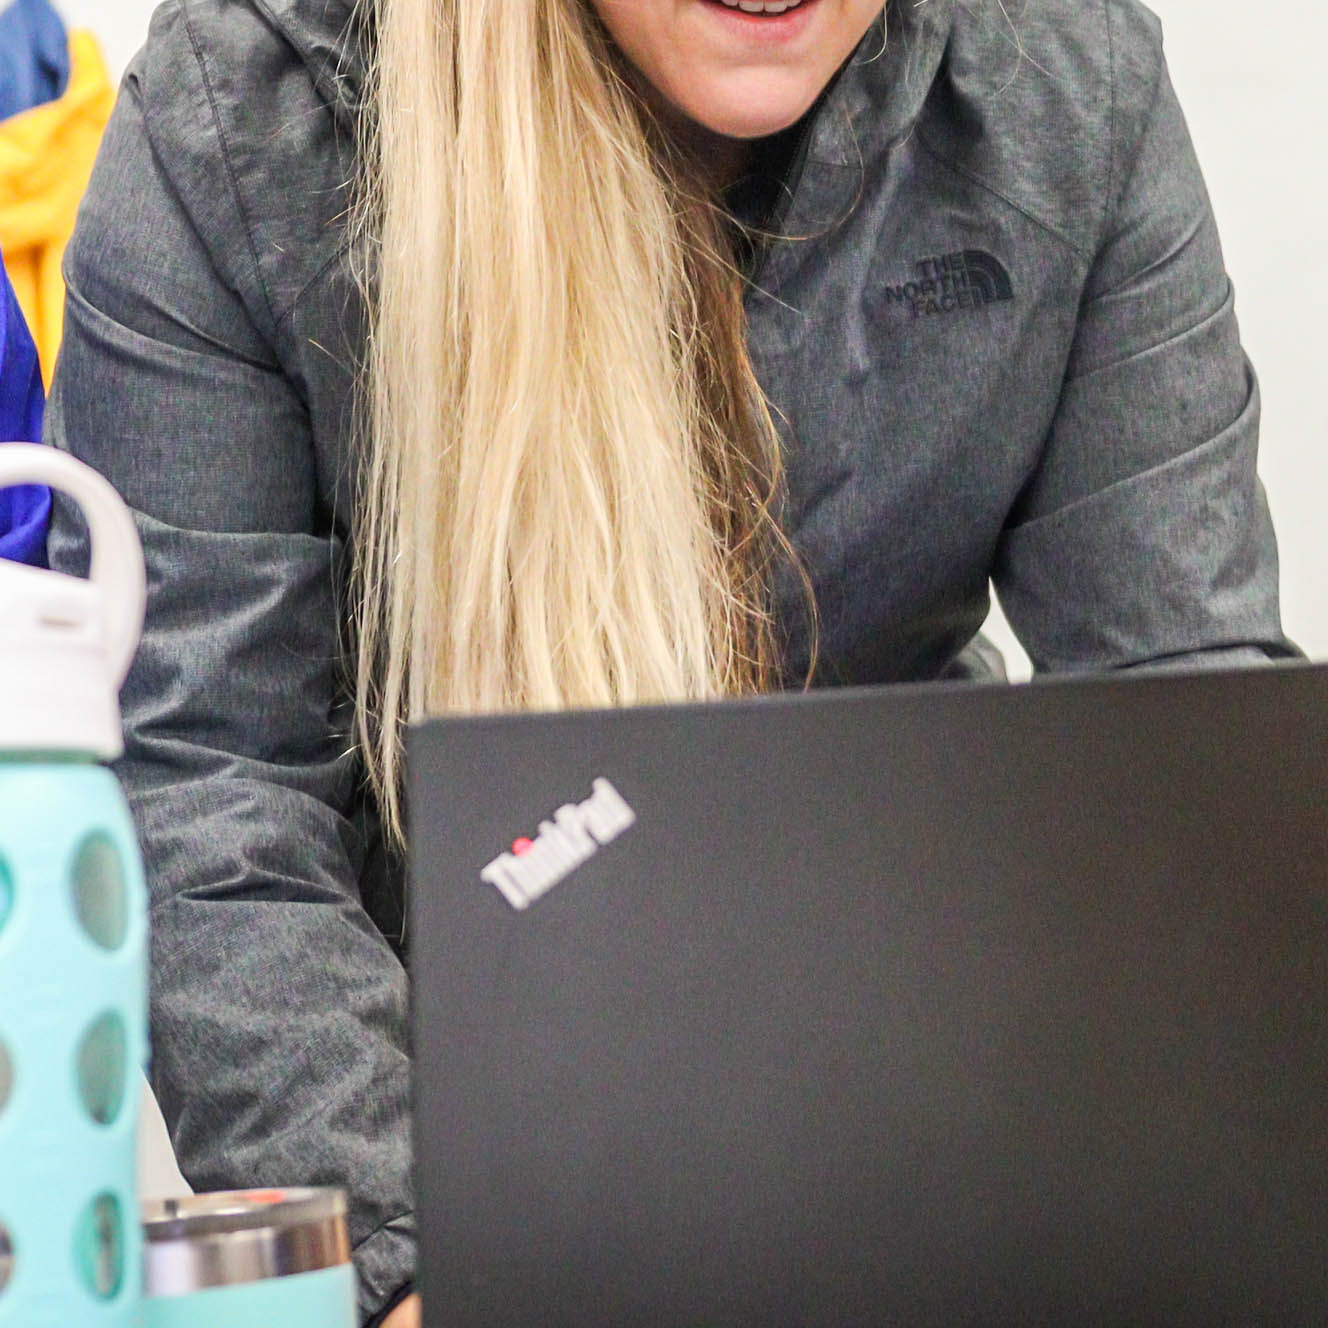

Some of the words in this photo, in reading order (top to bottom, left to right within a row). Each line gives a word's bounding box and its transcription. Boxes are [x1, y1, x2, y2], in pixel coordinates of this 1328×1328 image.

[917, 254, 965, 275] THE
[885, 274, 967, 303] NORTH
[913, 289, 970, 317] FACE
[480, 777, 636, 910] ThinkPad
